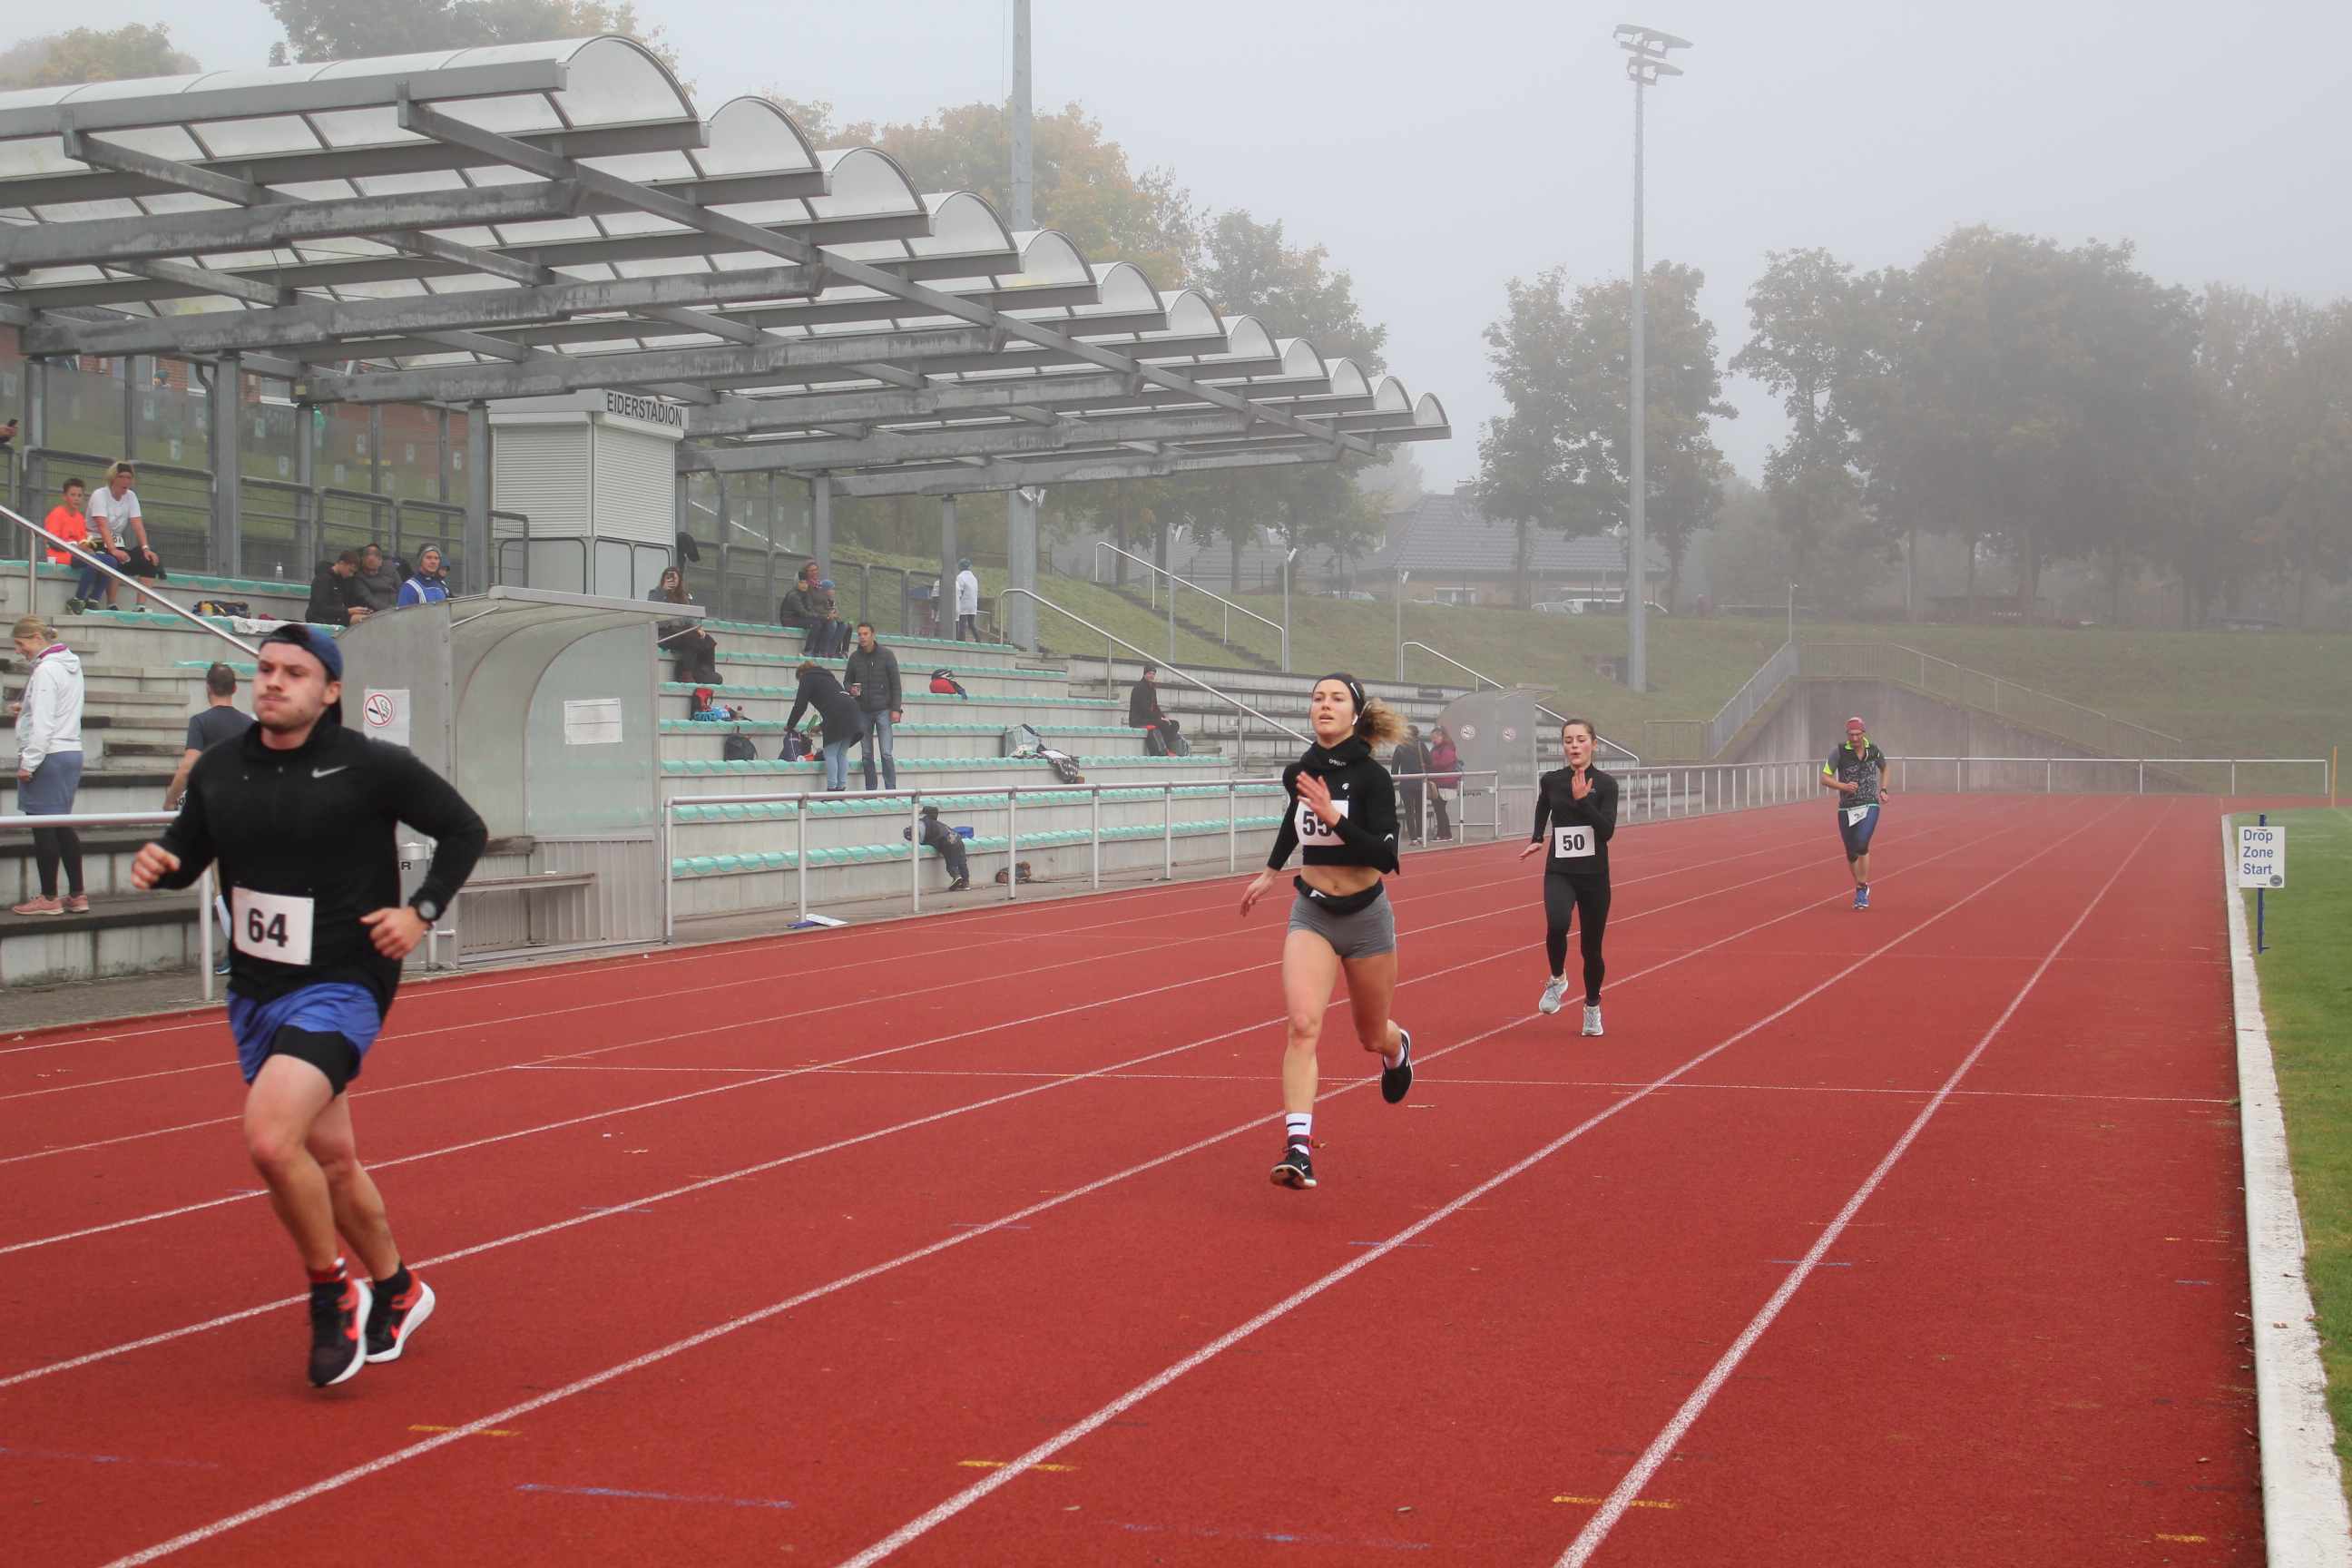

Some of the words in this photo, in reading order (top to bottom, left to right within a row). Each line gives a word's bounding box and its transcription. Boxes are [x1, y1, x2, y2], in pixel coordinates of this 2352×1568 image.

[607, 391, 682, 427] EIDERSTADION
[1302, 810, 1334, 837] 55
[1563, 834, 1585, 851] 50
[2243, 829, 2273, 844] Drop
[2242, 846, 2274, 858] Zone
[2242, 863, 2273, 875] Start
[247, 907, 289, 947] 64
